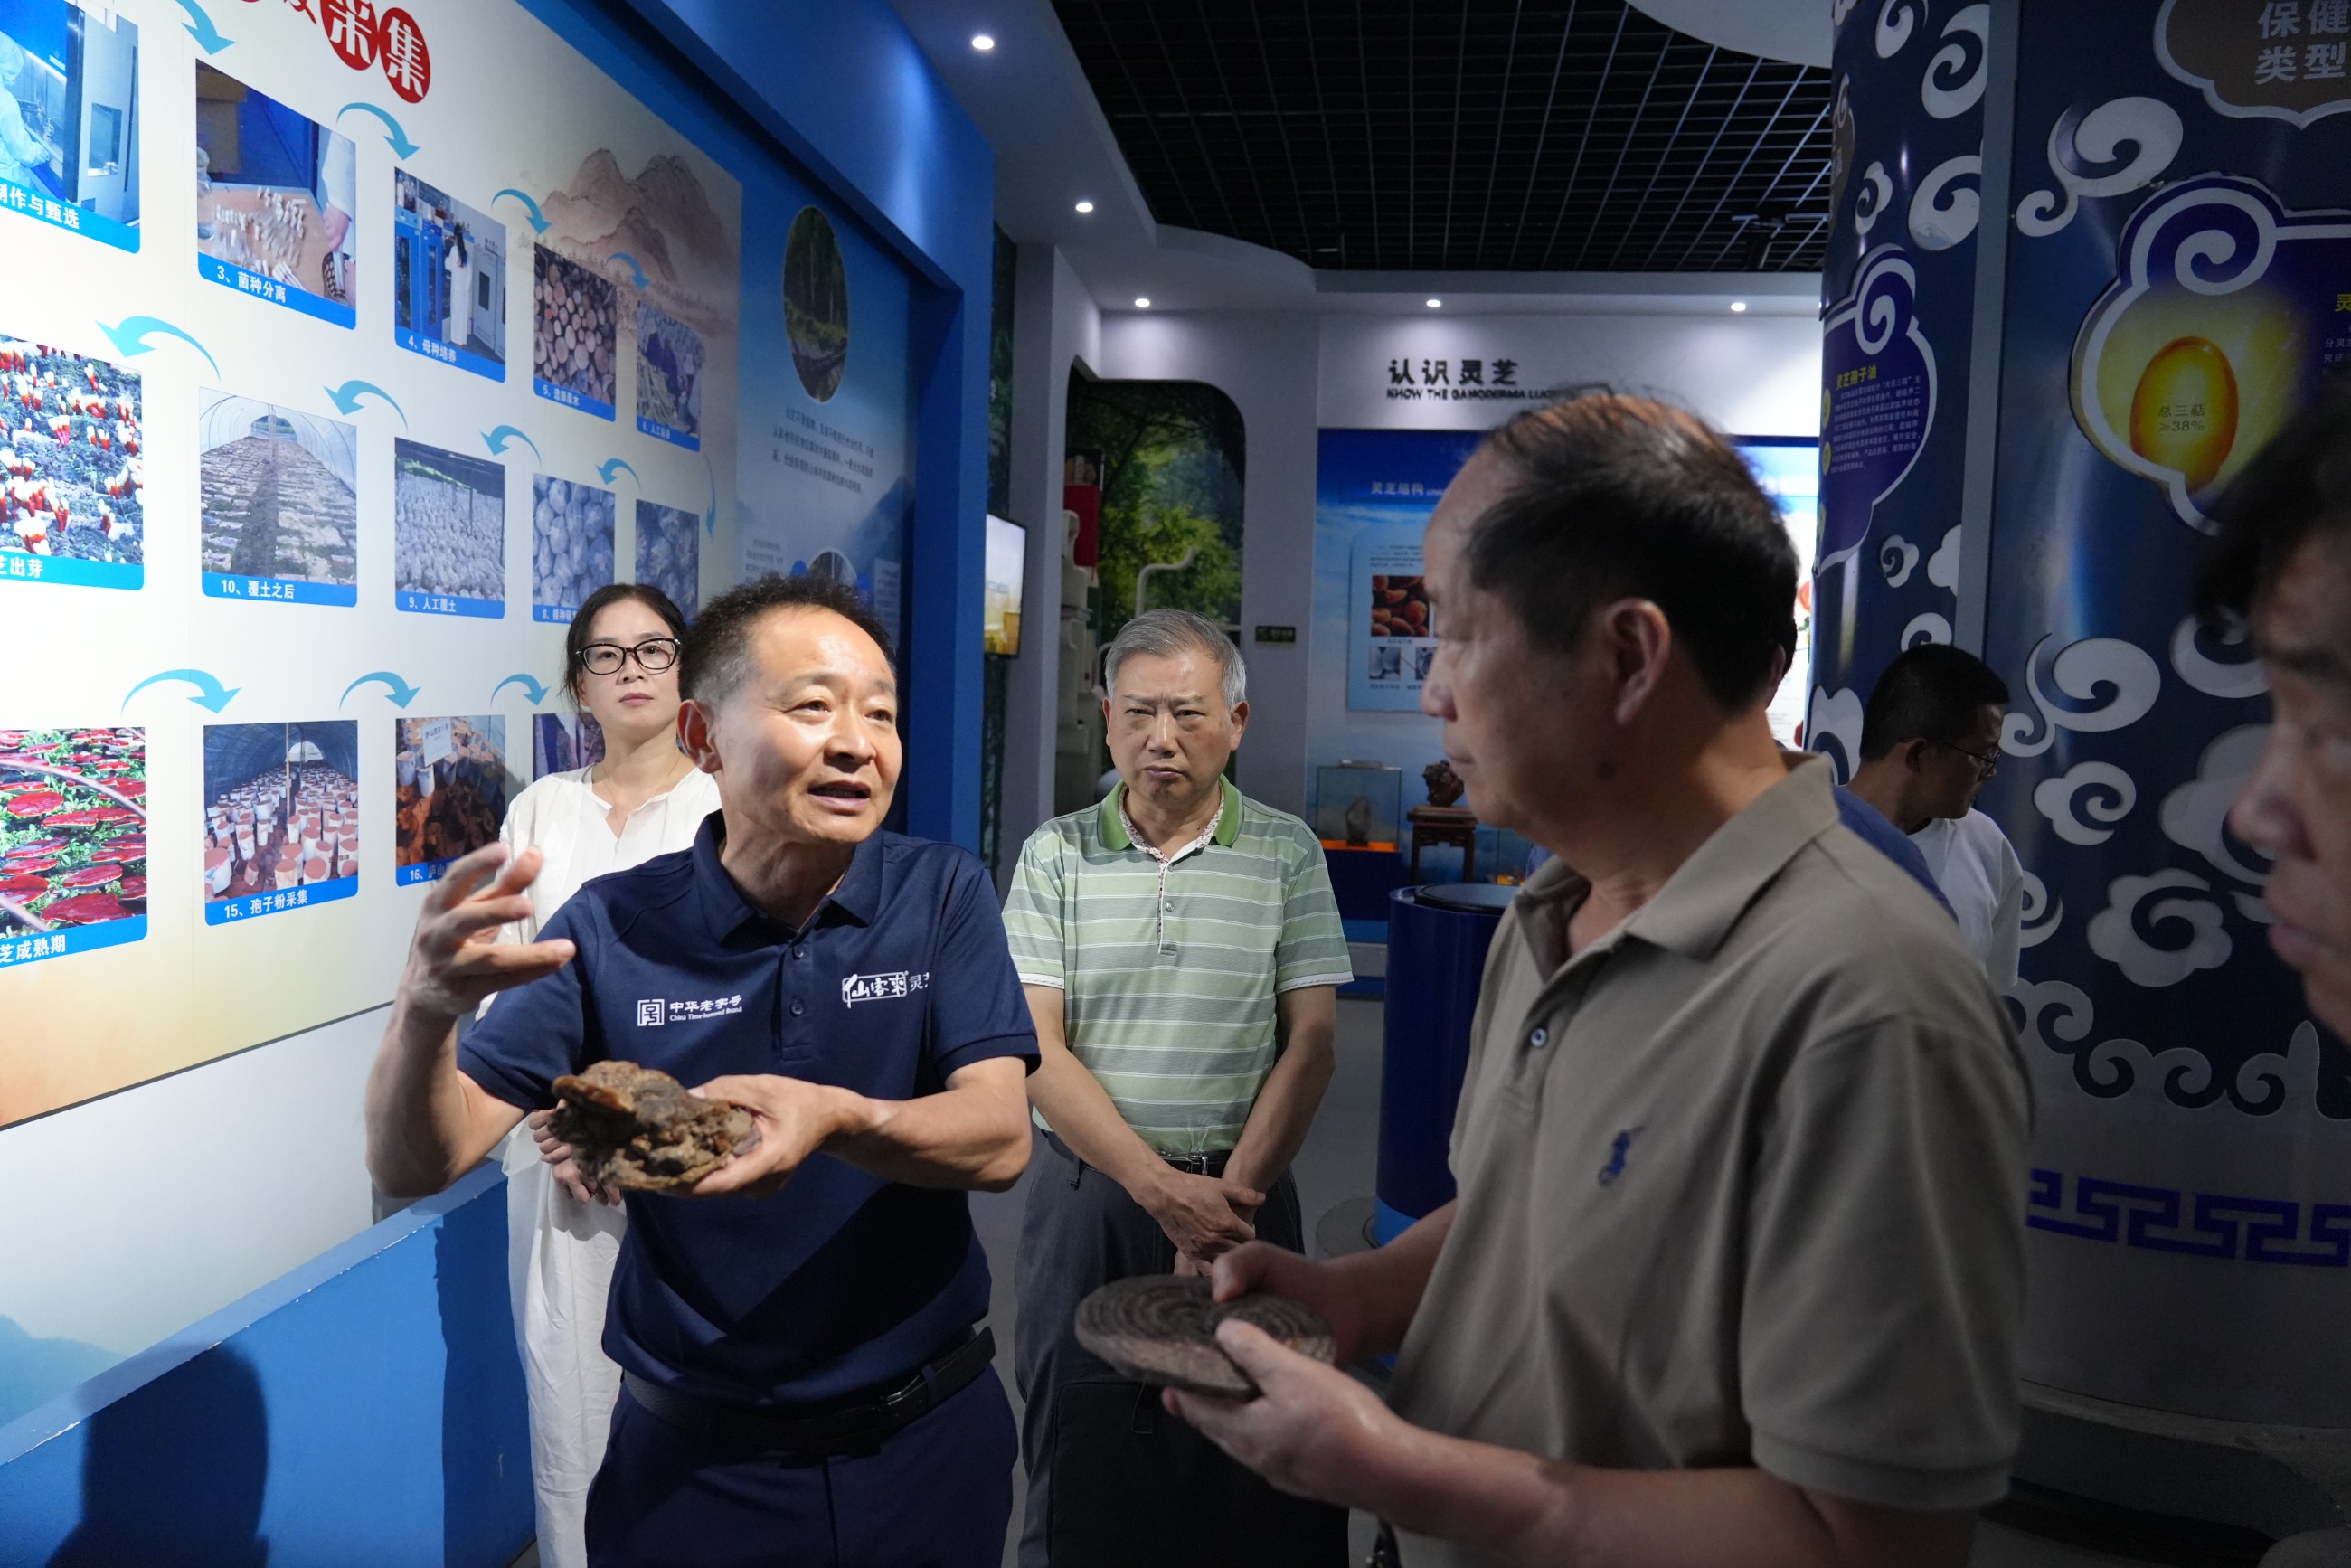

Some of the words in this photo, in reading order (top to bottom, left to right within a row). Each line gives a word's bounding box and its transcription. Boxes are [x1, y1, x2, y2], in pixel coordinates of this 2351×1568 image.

[2258, 0, 2351, 39] 保健
[283, 0, 425, 98] 采集
[2255, 42, 2346, 85] 类型
[217, 265, 287, 303] 3、菌种分离
[1387, 359, 1518, 385] 认识灵芝
[1427, 389, 1448, 401] THE
[221, 580, 295, 600] 10、覆土之后
[224, 889, 308, 918] 15、孢子粉采集
[0, 935, 66, 964] 芝成熟期
[669, 994, 742, 1013] 中华老字号
[669, 1014, 687, 1022] China
[687, 1008, 725, 1020] Time-honored
[725, 1006, 743, 1015] Brand
